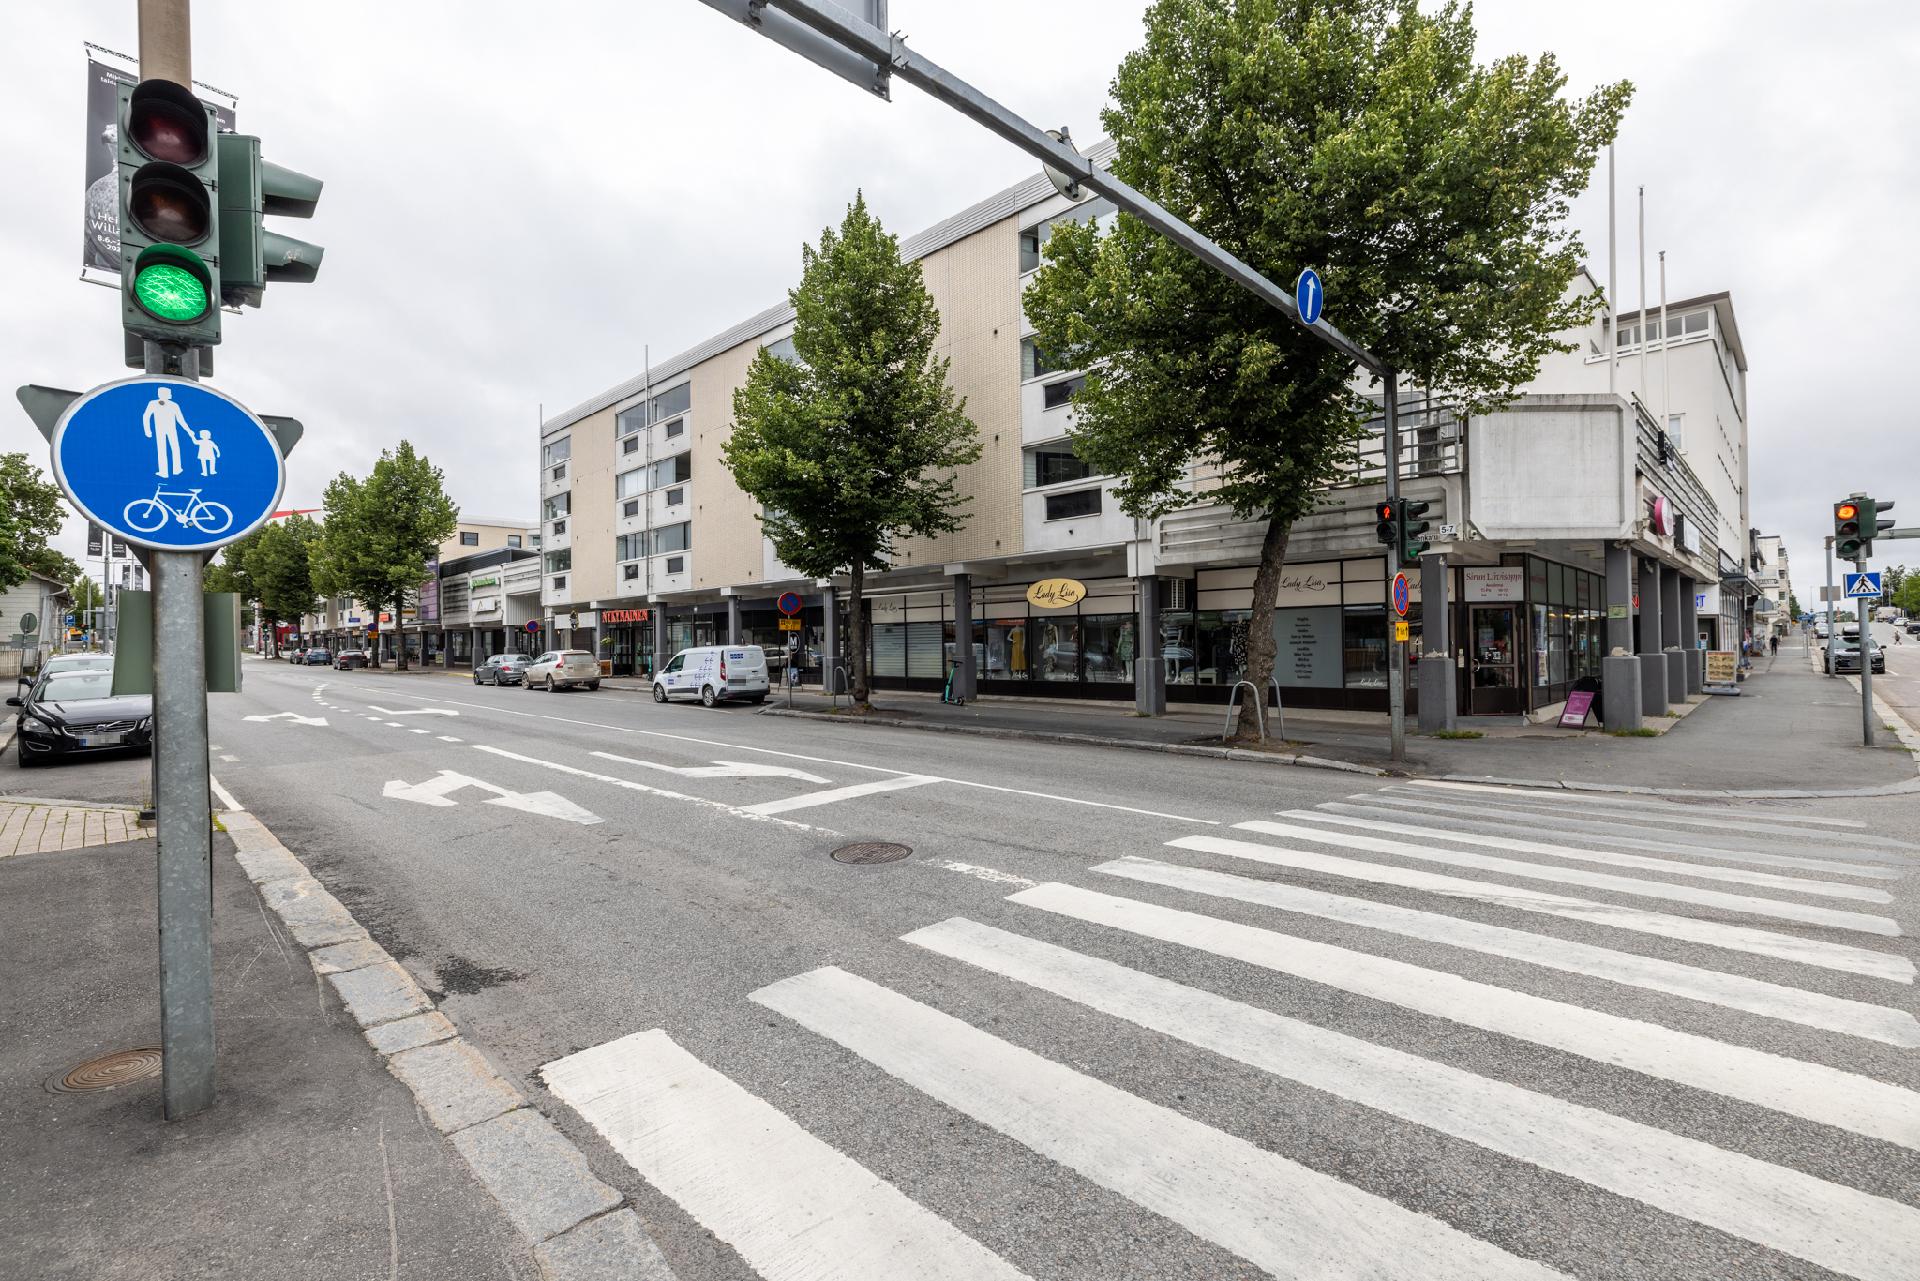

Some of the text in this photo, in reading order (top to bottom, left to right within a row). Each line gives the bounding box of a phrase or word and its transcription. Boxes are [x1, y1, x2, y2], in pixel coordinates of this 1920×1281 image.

[97, 211, 118, 225] Hei
[106, 244, 120, 252] 202
[1441, 525, 1454, 534] 5-7
[1280, 575, 1326, 592] Lady Lisa
[1033, 582, 1079, 604] Lady Lisa
